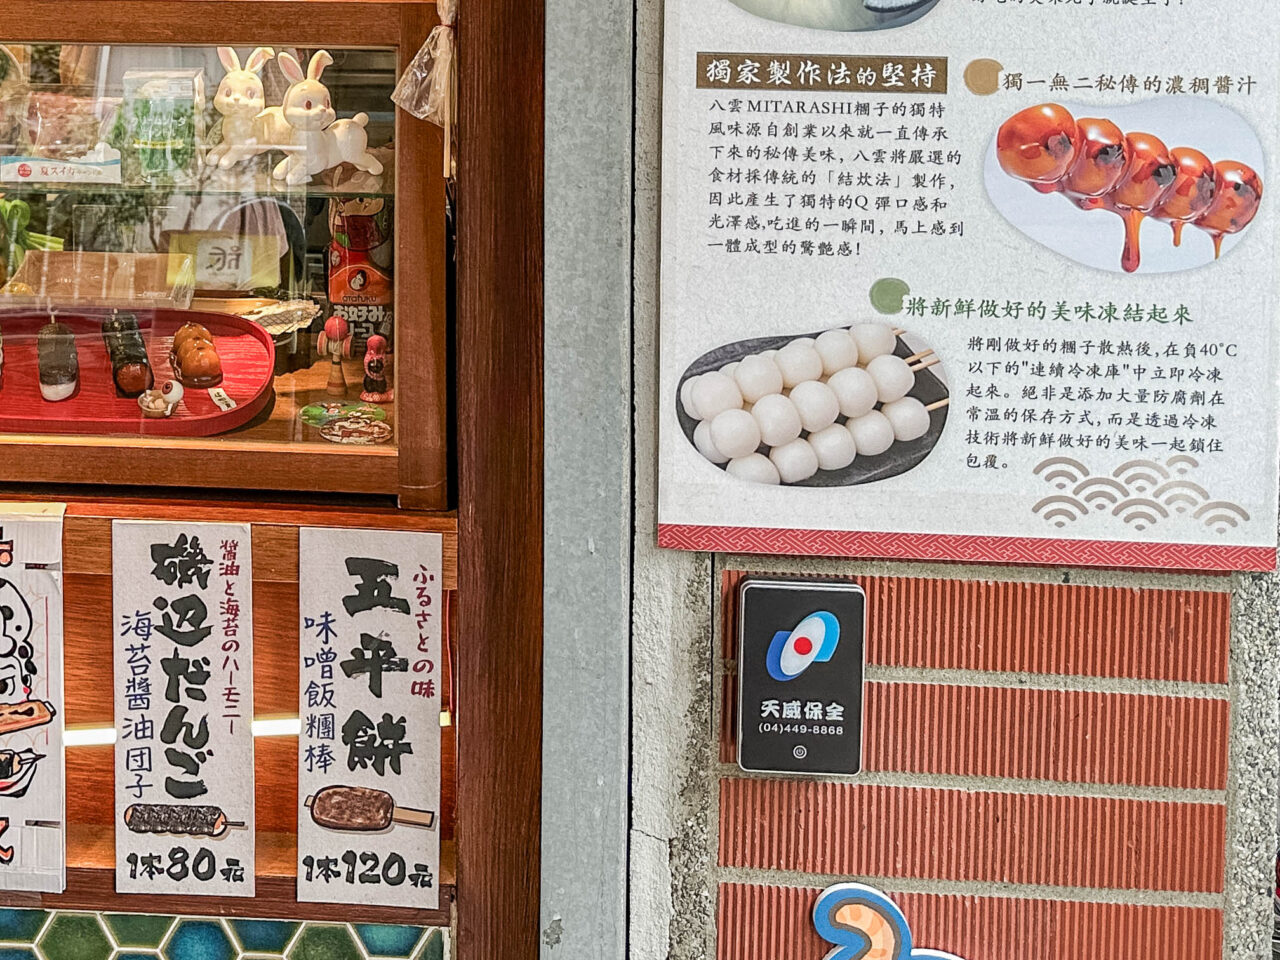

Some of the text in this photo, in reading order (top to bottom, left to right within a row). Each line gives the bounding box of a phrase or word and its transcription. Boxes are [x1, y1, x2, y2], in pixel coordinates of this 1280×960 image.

[706, 58, 937, 88] 獨家製作法的堅持
[708, 120, 949, 141] 風味源自創業以來就一直傳承
[906, 297, 1194, 326] 將新鮮做好的美味凍結起來
[410, 565, 437, 700] ふるさとの味
[151, 533, 215, 800] 磯辺だんご
[339, 556, 414, 777] 五平餅
[761, 699, 845, 721] 天威保全
[758, 722, 844, 735] (04)449-8868
